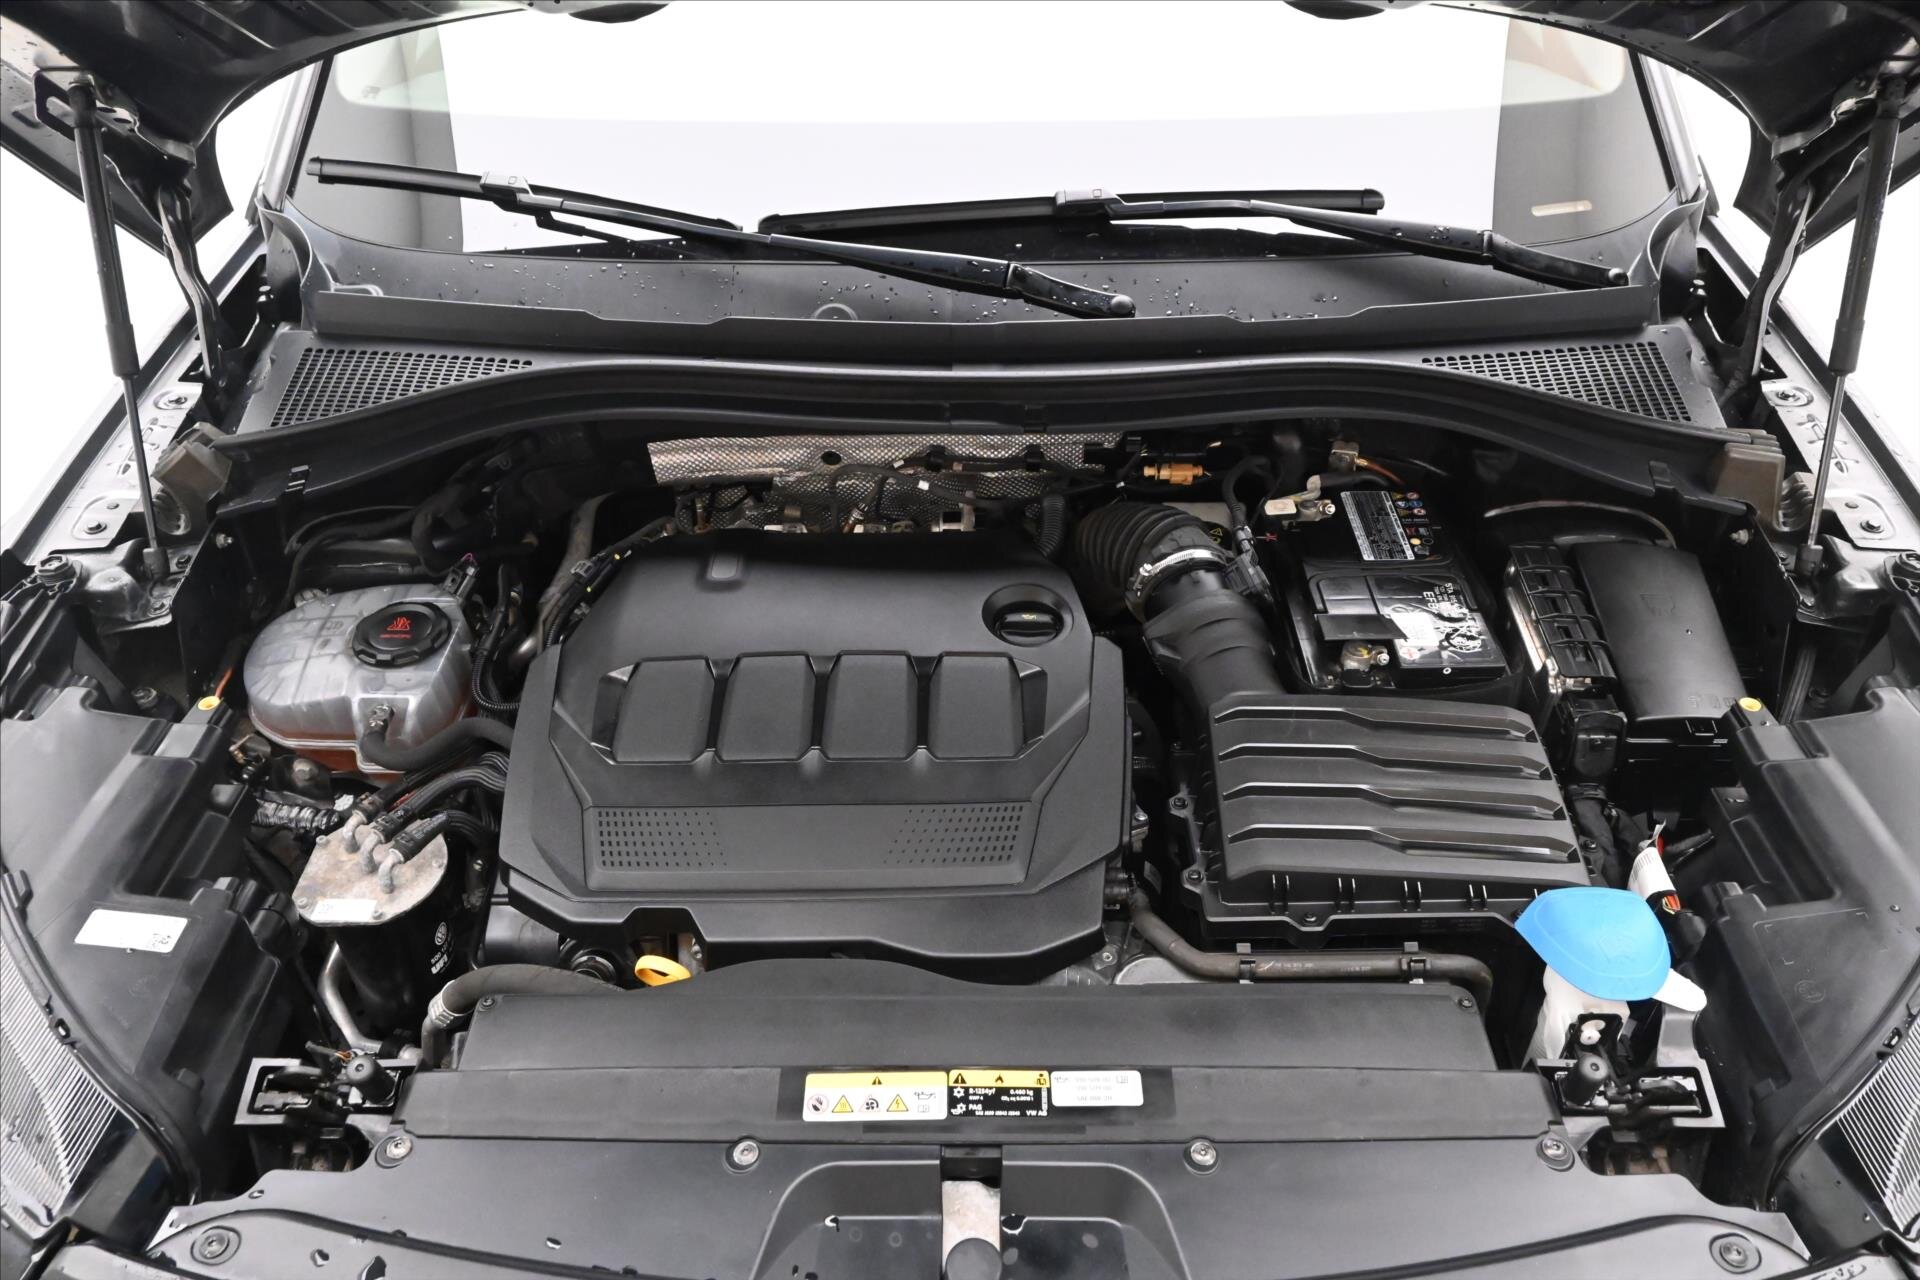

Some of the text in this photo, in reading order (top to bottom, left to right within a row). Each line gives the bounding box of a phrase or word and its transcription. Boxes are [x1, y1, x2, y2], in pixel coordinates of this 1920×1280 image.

[1422, 591, 1440, 610] EFB
[968, 1103, 983, 1111] PAG
[1025, 1109, 1037, 1117] VW
